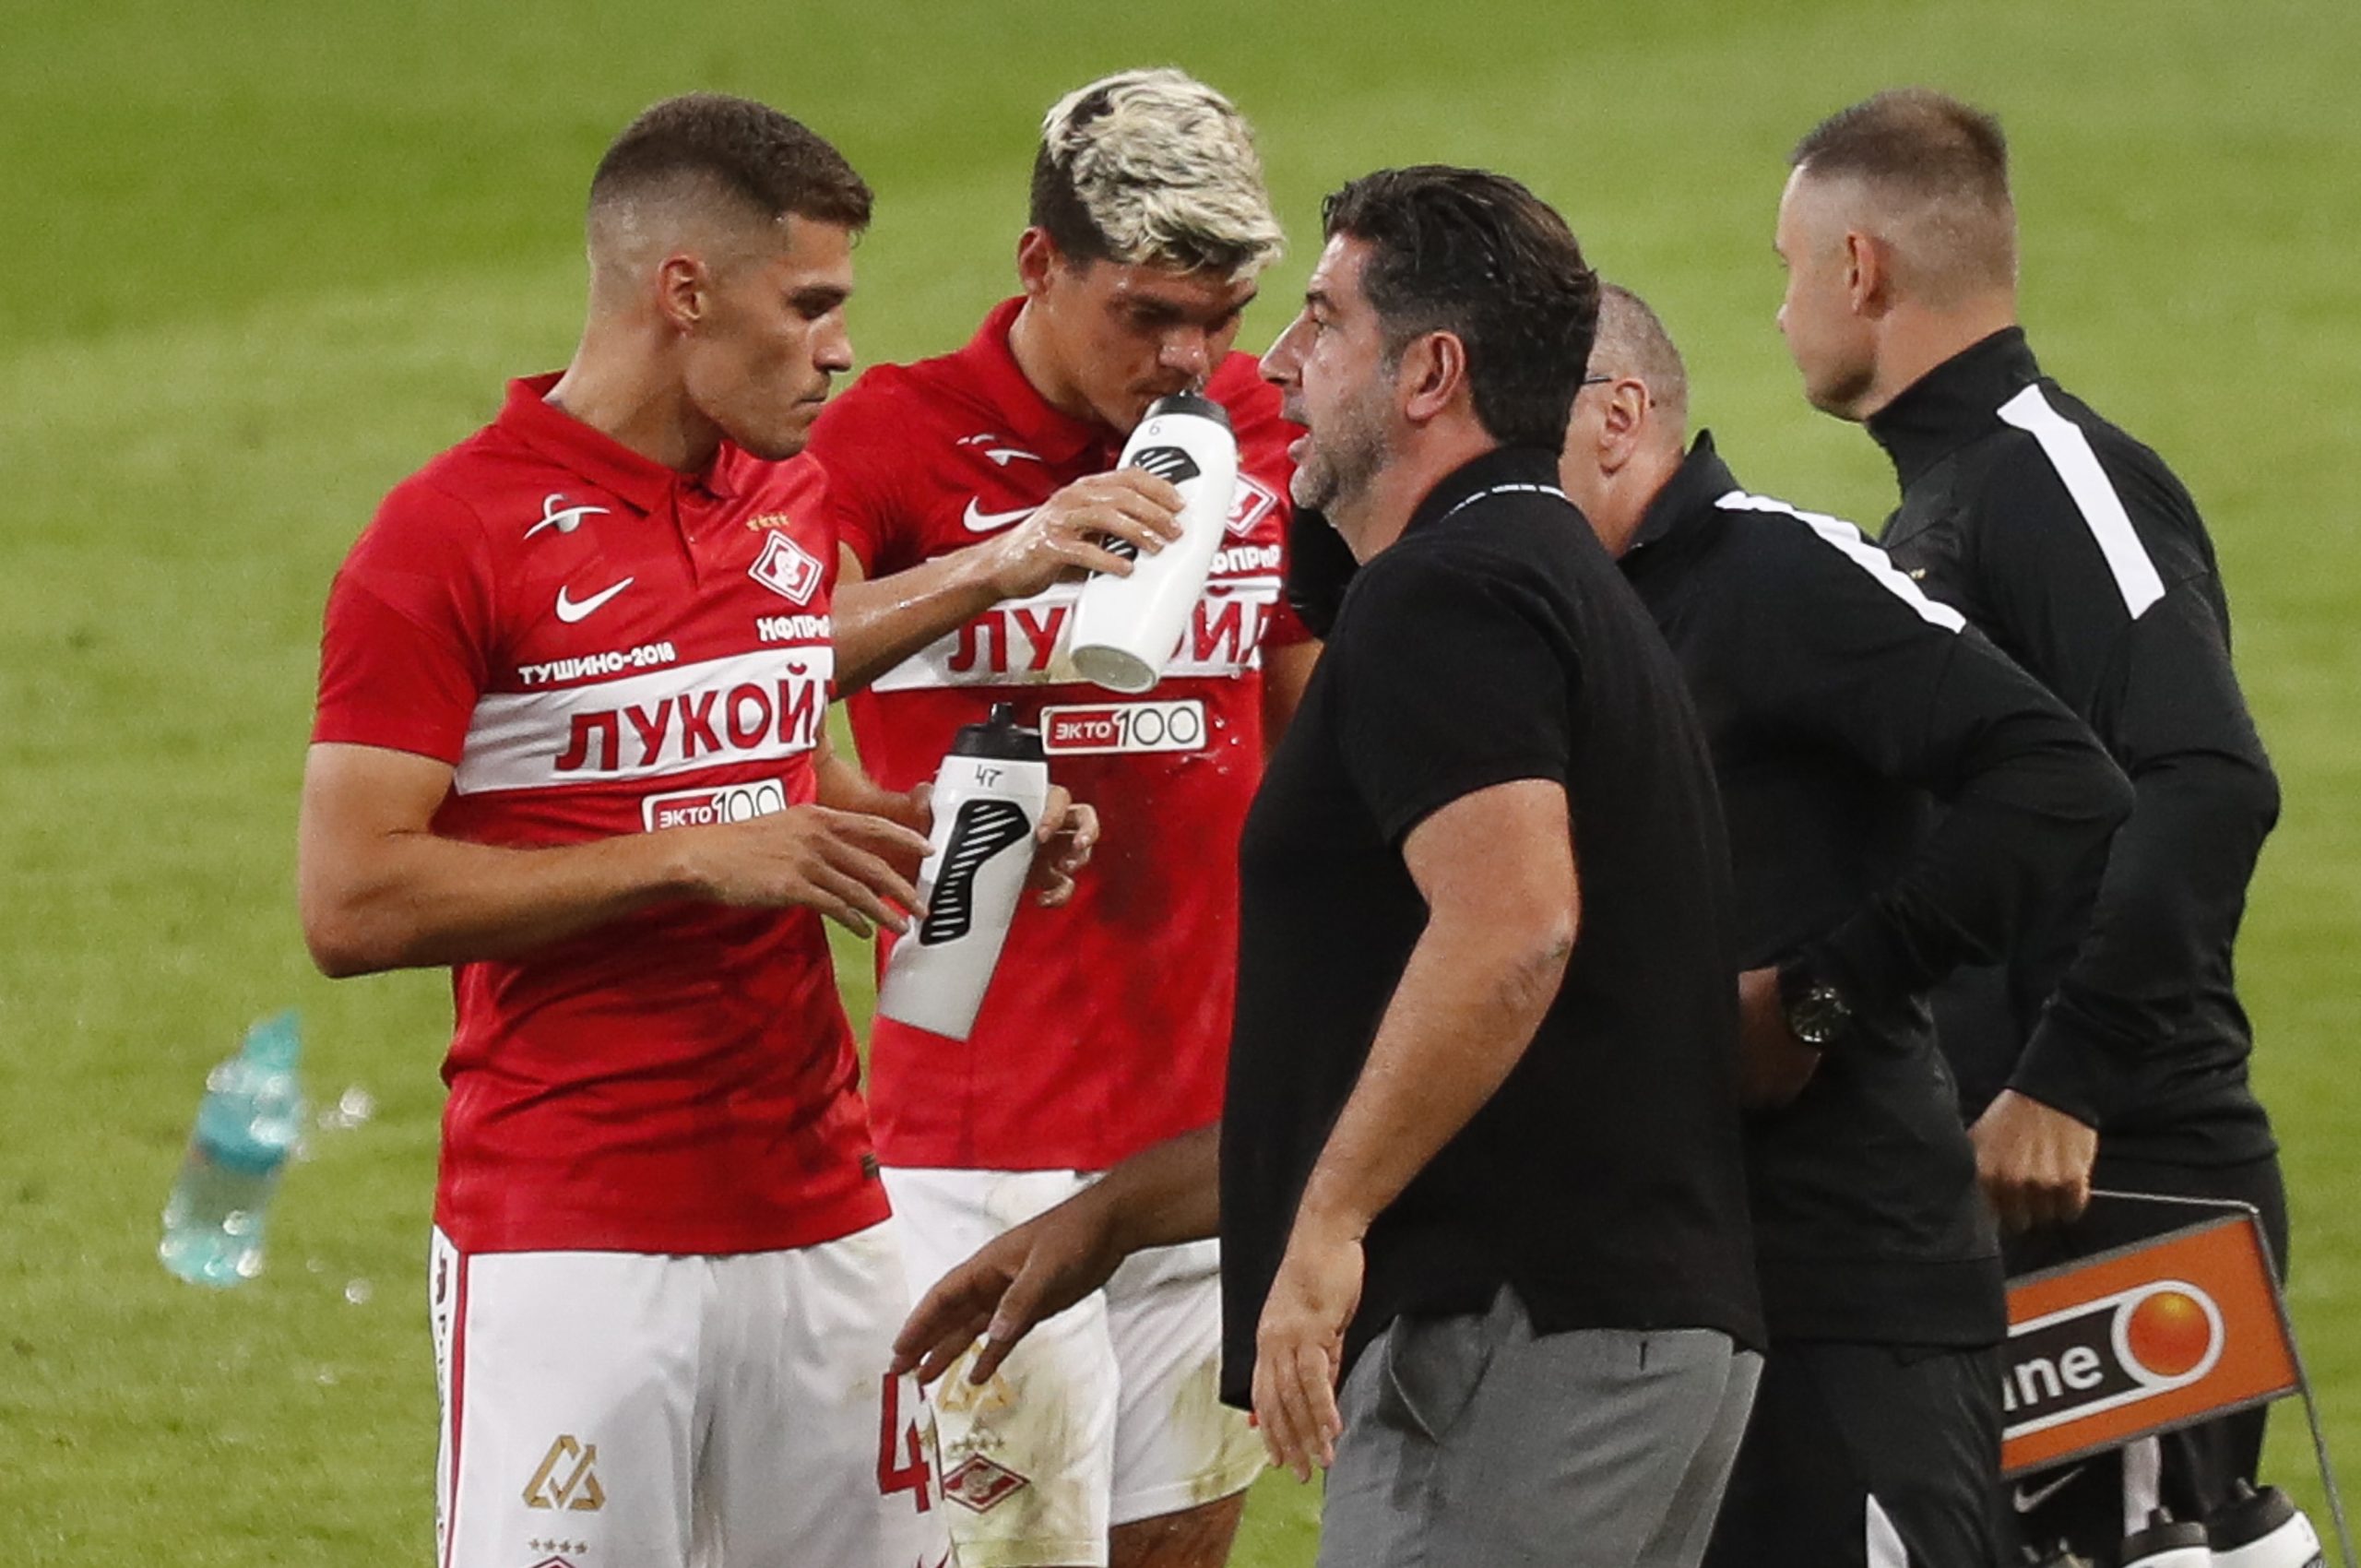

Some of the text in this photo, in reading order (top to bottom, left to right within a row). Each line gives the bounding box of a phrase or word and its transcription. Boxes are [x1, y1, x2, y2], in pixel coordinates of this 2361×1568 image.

[517, 642, 676, 684] ТУШИНО-2018
[553, 662, 831, 773] ЛУКОЙ
[975, 764, 1003, 788] 47
[877, 1372, 943, 1514] 4
